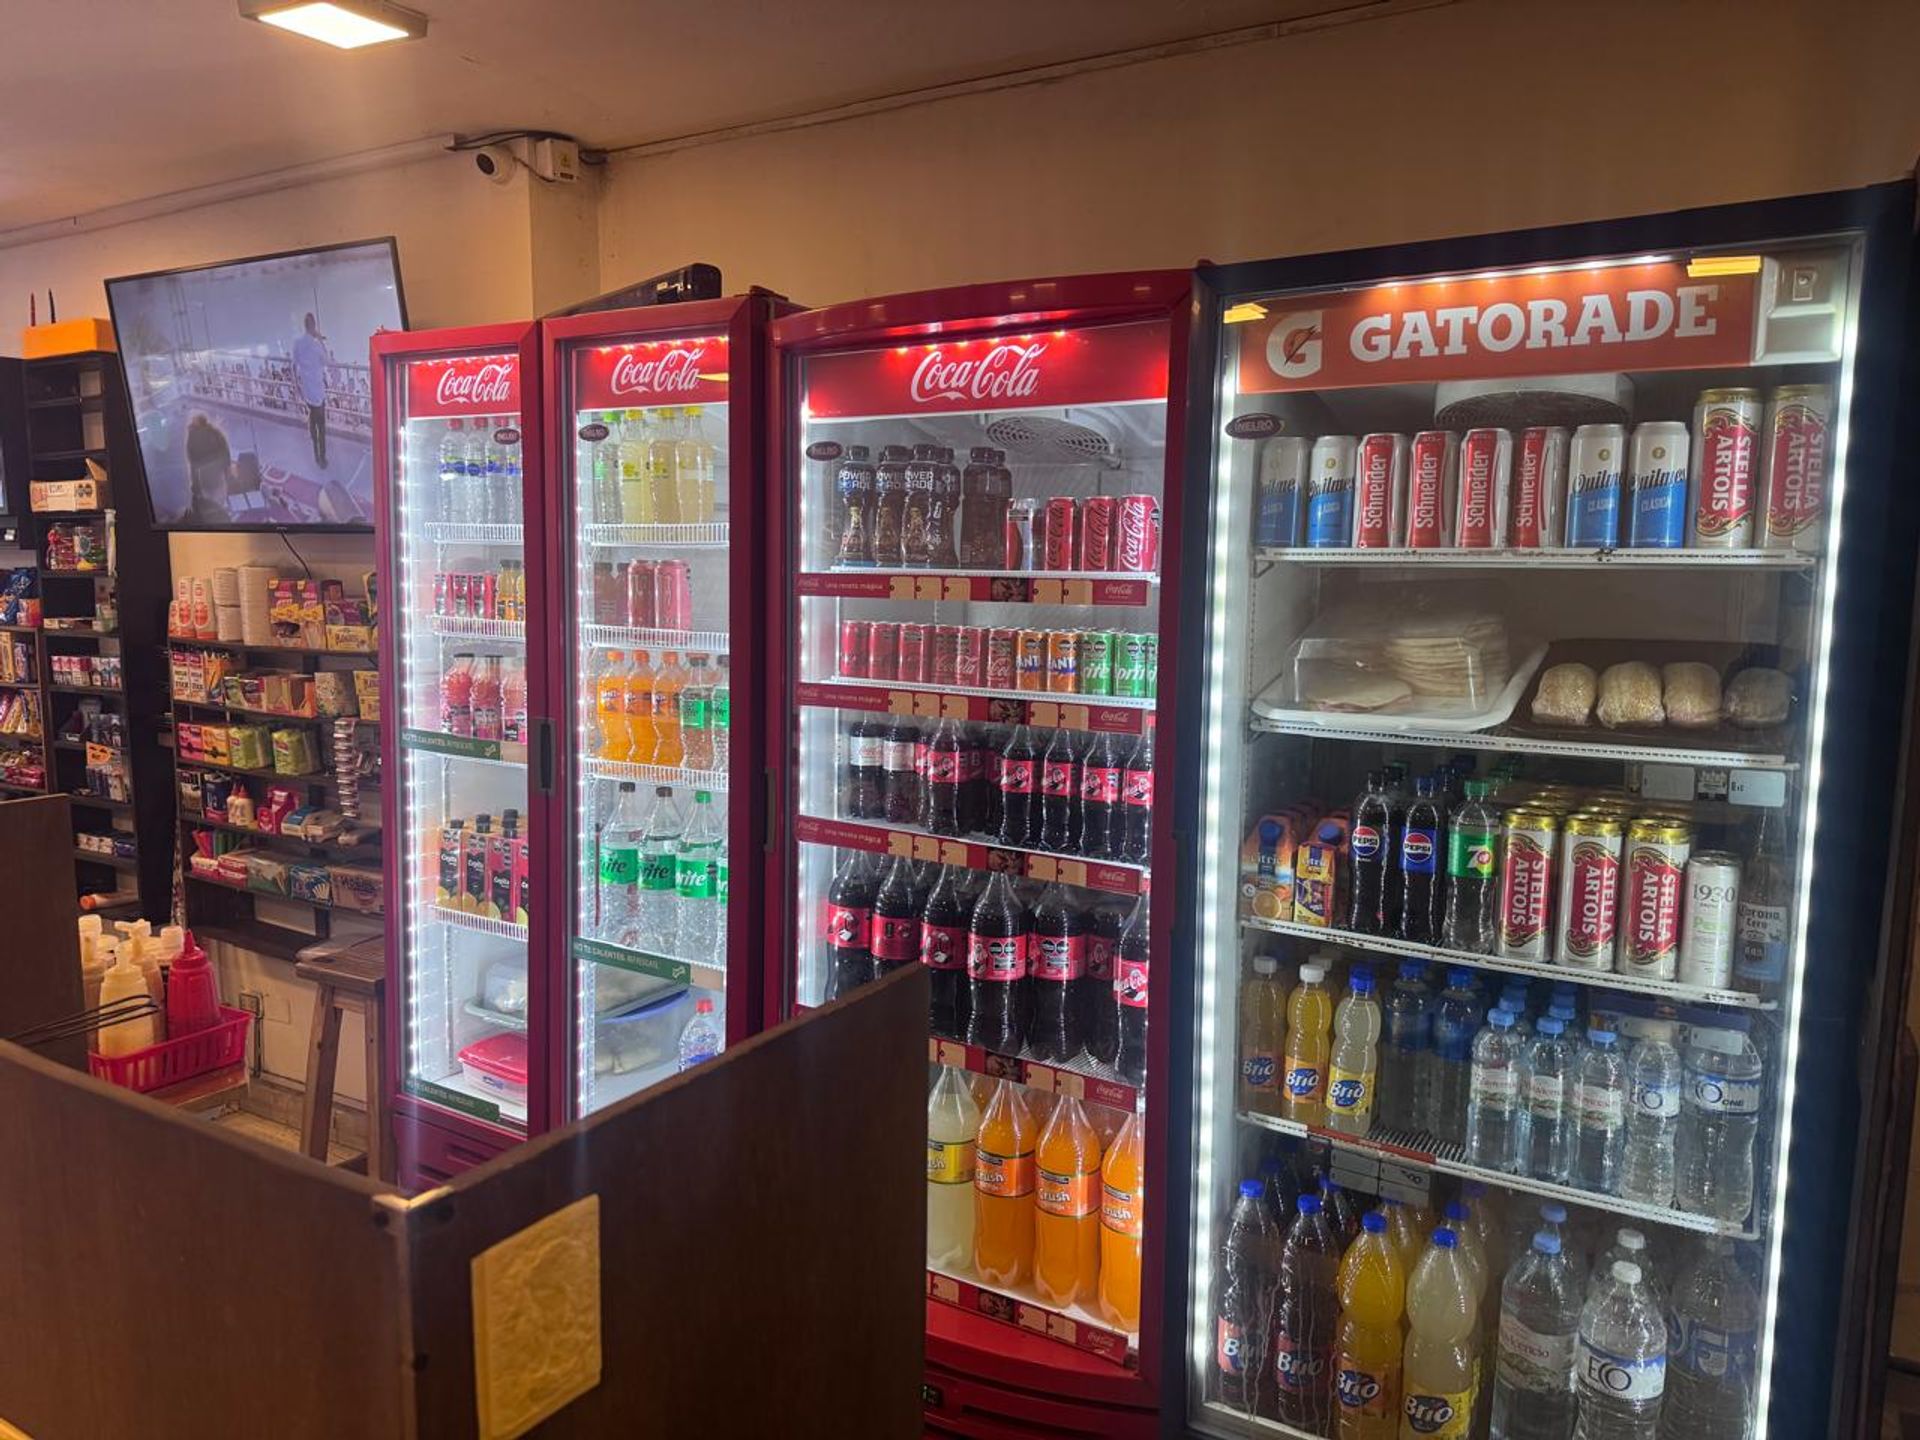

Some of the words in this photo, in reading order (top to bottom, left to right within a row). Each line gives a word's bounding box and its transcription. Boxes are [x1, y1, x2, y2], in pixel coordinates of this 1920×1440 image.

[1349, 284, 1718, 362] GATORADE
[437, 363, 512, 405] Coca-Cola
[611, 349, 704, 395] Coca-Cola
[911, 343, 1048, 403] Coca-Cola
[1364, 453, 1388, 530] Schneider
[1415, 451, 1438, 529] Schneider
[1467, 449, 1490, 528] Schneider
[1515, 449, 1538, 527] Schneider
[1711, 433, 1731, 512] ARTOIS
[1733, 435, 1752, 511] STELLA
[1784, 433, 1804, 511] ARTOIS
[1804, 433, 1825, 511] STELLA
[1121, 499, 1146, 572] Coca-Cola
[1353, 836, 1379, 846] PEPSI
[1404, 843, 1431, 853] PEPSI
[1511, 857, 1530, 926] ARTOIS
[1529, 858, 1547, 927] STELLA
[1582, 864, 1600, 936] ARTOIS
[1600, 865, 1617, 939] STELLA
[1639, 870, 1658, 942] ARTOIS
[1658, 874, 1676, 944] STELLA
